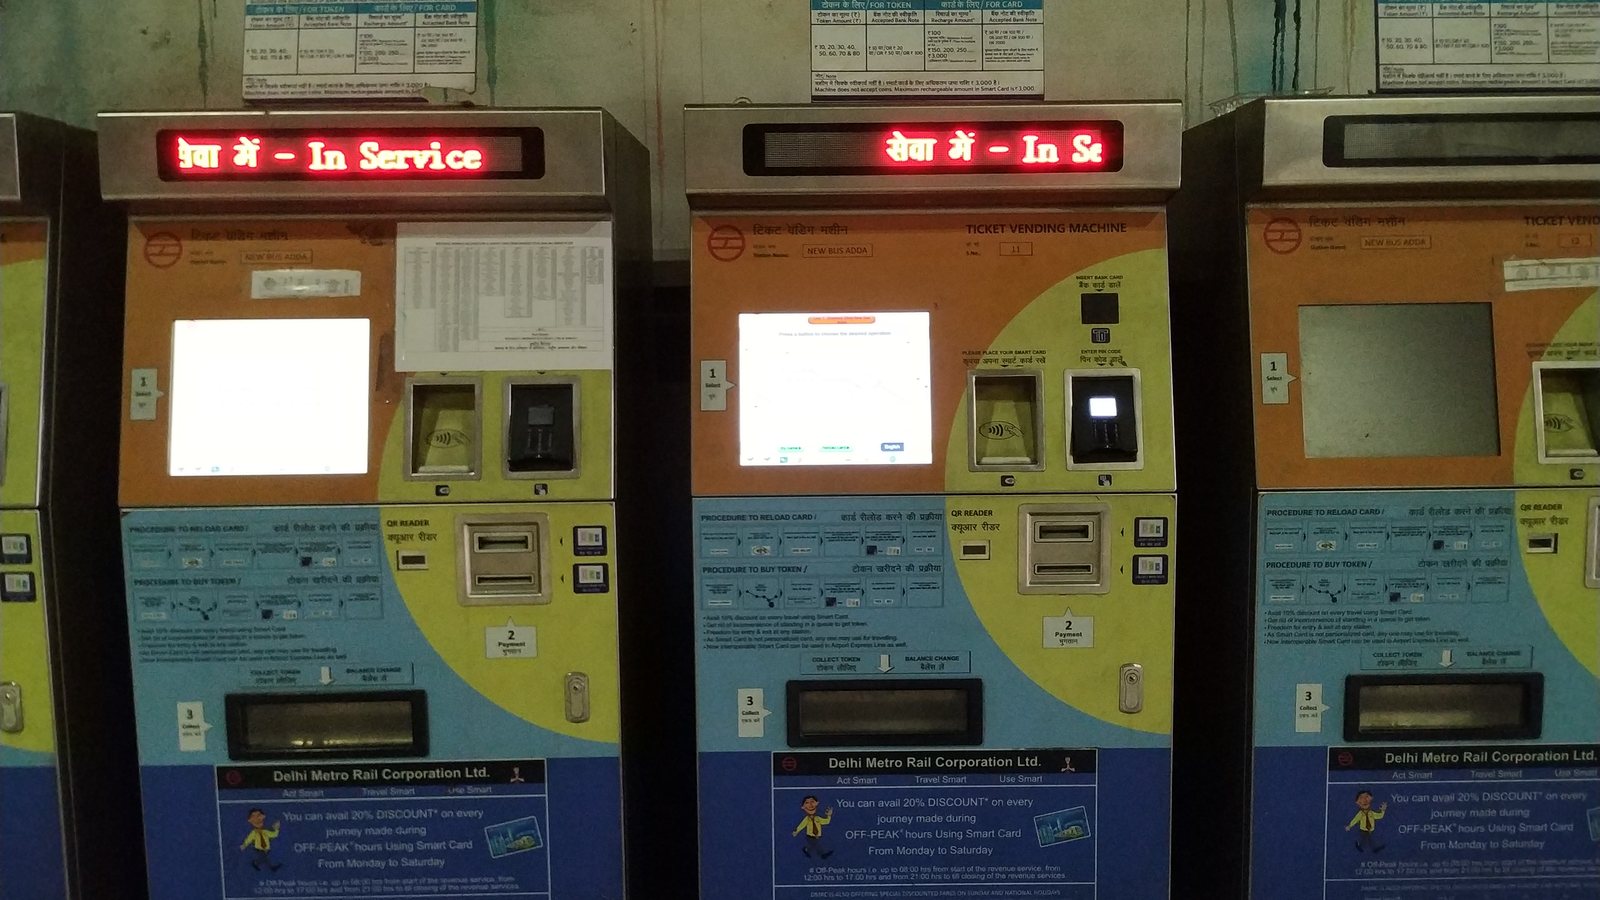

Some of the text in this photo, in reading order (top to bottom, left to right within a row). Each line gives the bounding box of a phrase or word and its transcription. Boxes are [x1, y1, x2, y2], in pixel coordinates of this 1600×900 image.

[886, 131, 937, 161] सेवा
[949, 130, 976, 161] में
[1022, 135, 1059, 163] In
[233, 136, 260, 168] में
[308, 142, 348, 170] In
[359, 142, 482, 170] Service
[752, 223, 781, 235] टिकट
[820, 223, 848, 235] मशीन
[967, 223, 1127, 234] TICKET VENDING MACHINE
[1364, 239, 1426, 247] NEW BUS ADDA
[1270, 362, 1277, 371] 1
[709, 368, 716, 378] 1
[1065, 621, 1073, 630] 2
[507, 630, 515, 640] 2
[746, 696, 754, 706] 3
[1305, 691, 1312, 701] 3
[828, 755, 1041, 770] Delhi Metro Rail Corporation Ltd.
[1385, 751, 1597, 765] Delhi Metro Rail Corporation Ltd.
[273, 767, 490, 782] Delhi Metro Rail Corporation Ltd.
[836, 776, 878, 784] Act Smart
[999, 775, 1043, 783] Use Smart
[836, 799, 855, 808] You
[857, 799, 875, 808] can
[878, 798, 901, 807] avail
[903, 798, 925, 807] 20%
[991, 797, 1004, 806] on
[1006, 799, 1034, 808] every
[1390, 793, 1409, 803] You
[1412, 793, 1430, 803] can
[1432, 793, 1455, 802] avail
[1458, 793, 1479, 802] 20%
[1545, 791, 1558, 801] on
[1560, 793, 1587, 801] every
[877, 814, 976, 824] journey made during
[905, 829, 933, 838] hours
[935, 829, 963, 840] Using
[966, 829, 995, 838] Smart
[998, 829, 1022, 838] Card
[868, 846, 993, 858] From Monday to Saturday
[318, 858, 445, 870] From Monday to Saturday
